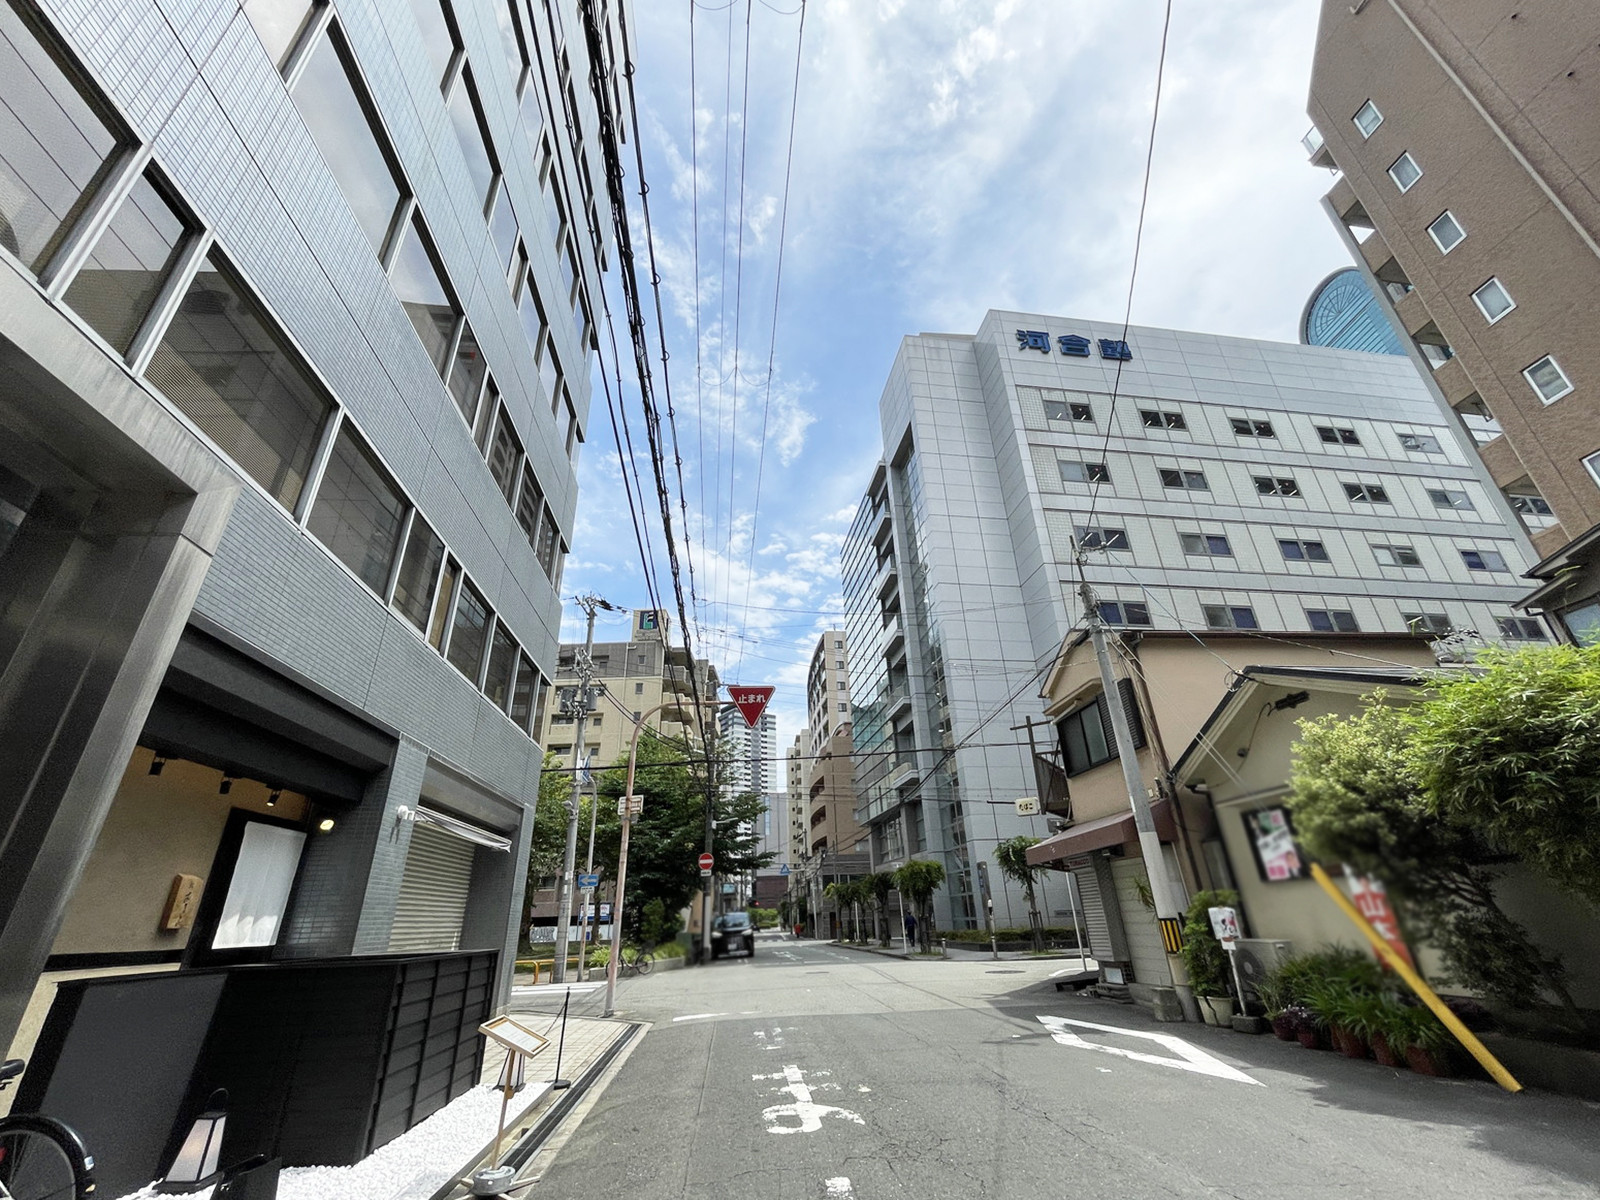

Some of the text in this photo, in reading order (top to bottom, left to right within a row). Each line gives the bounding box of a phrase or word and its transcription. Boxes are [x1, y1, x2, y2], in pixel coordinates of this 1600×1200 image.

[1016, 329, 1133, 361] 河合塾
[738, 694, 766, 704] 止まれ
[1018, 802, 1034, 811] たばこ
